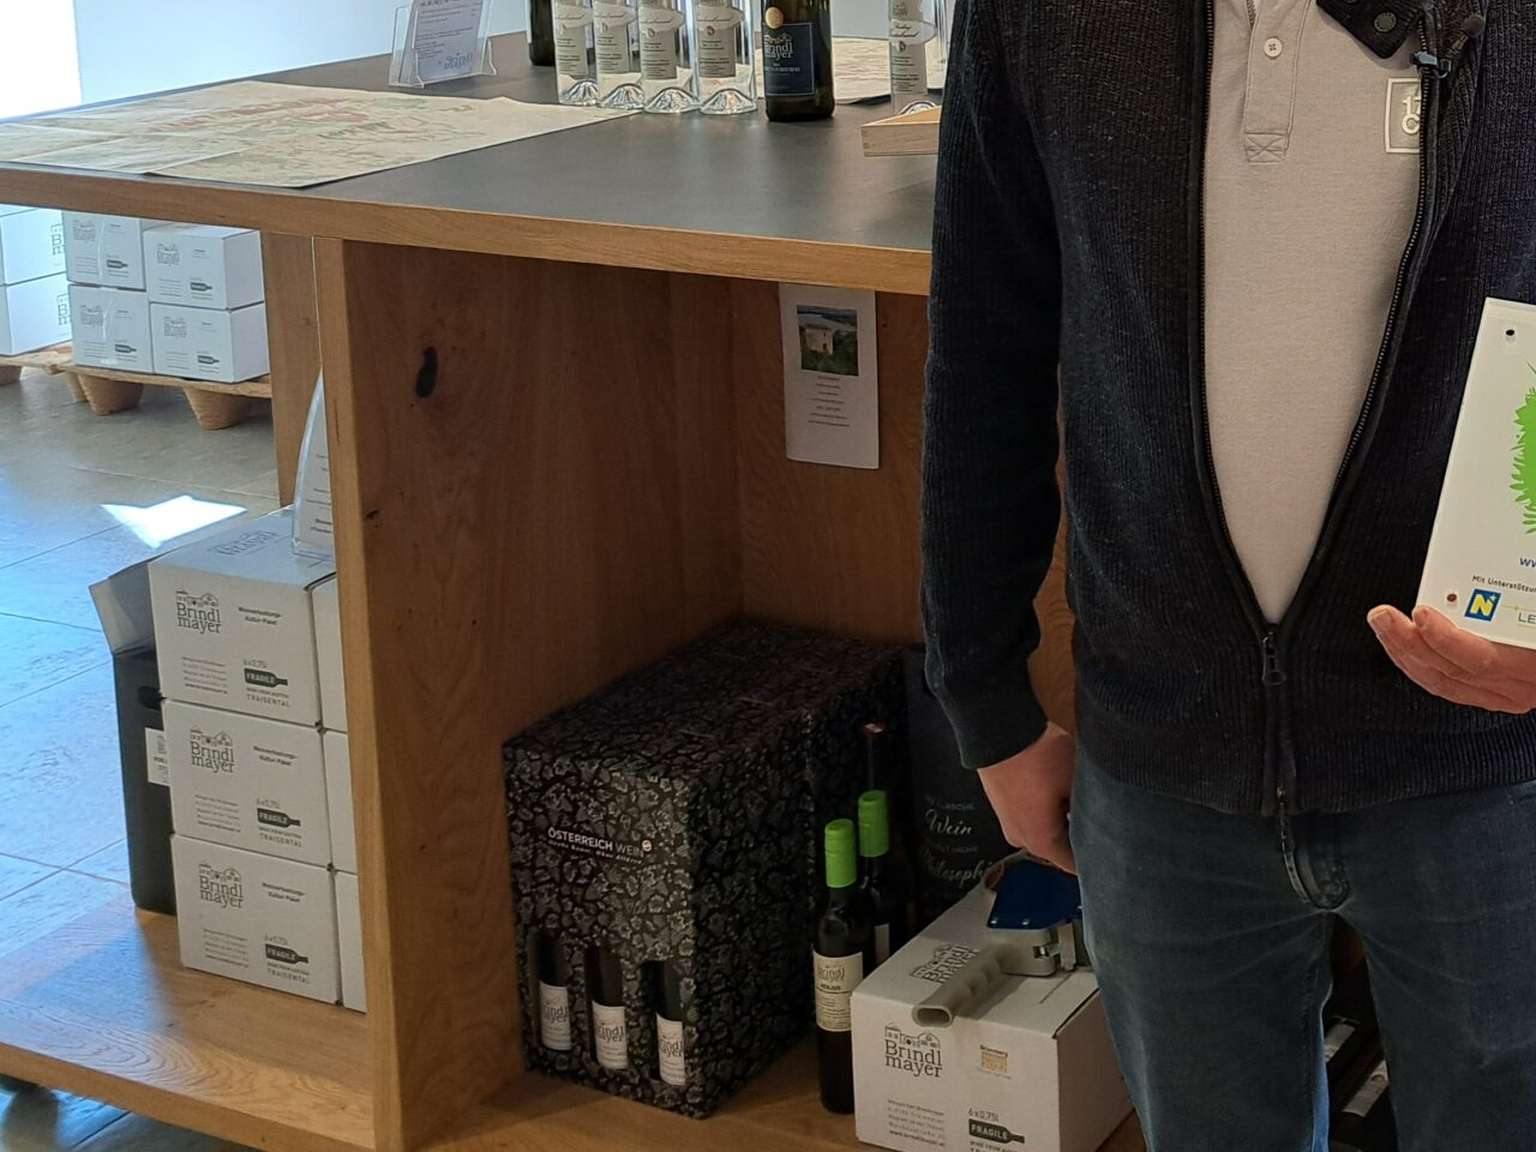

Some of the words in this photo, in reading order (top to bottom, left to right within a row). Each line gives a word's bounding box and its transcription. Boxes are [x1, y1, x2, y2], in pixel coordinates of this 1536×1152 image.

[1471, 574, 1486, 585] Mit
[176, 602, 221, 623] Brindl
[1518, 612, 1536, 625] LE
[177, 616, 222, 634] mayer
[191, 741, 235, 762] Brindl
[191, 754, 235, 773] mayer
[547, 826, 613, 852] ÖSTERREICH
[199, 875, 243, 898] Brindl
[200, 889, 244, 909] mayer
[884, 1038, 943, 1067] Brindl
[885, 1055, 943, 1078] mayer
[970, 1123, 1009, 1141] FRAGILE
